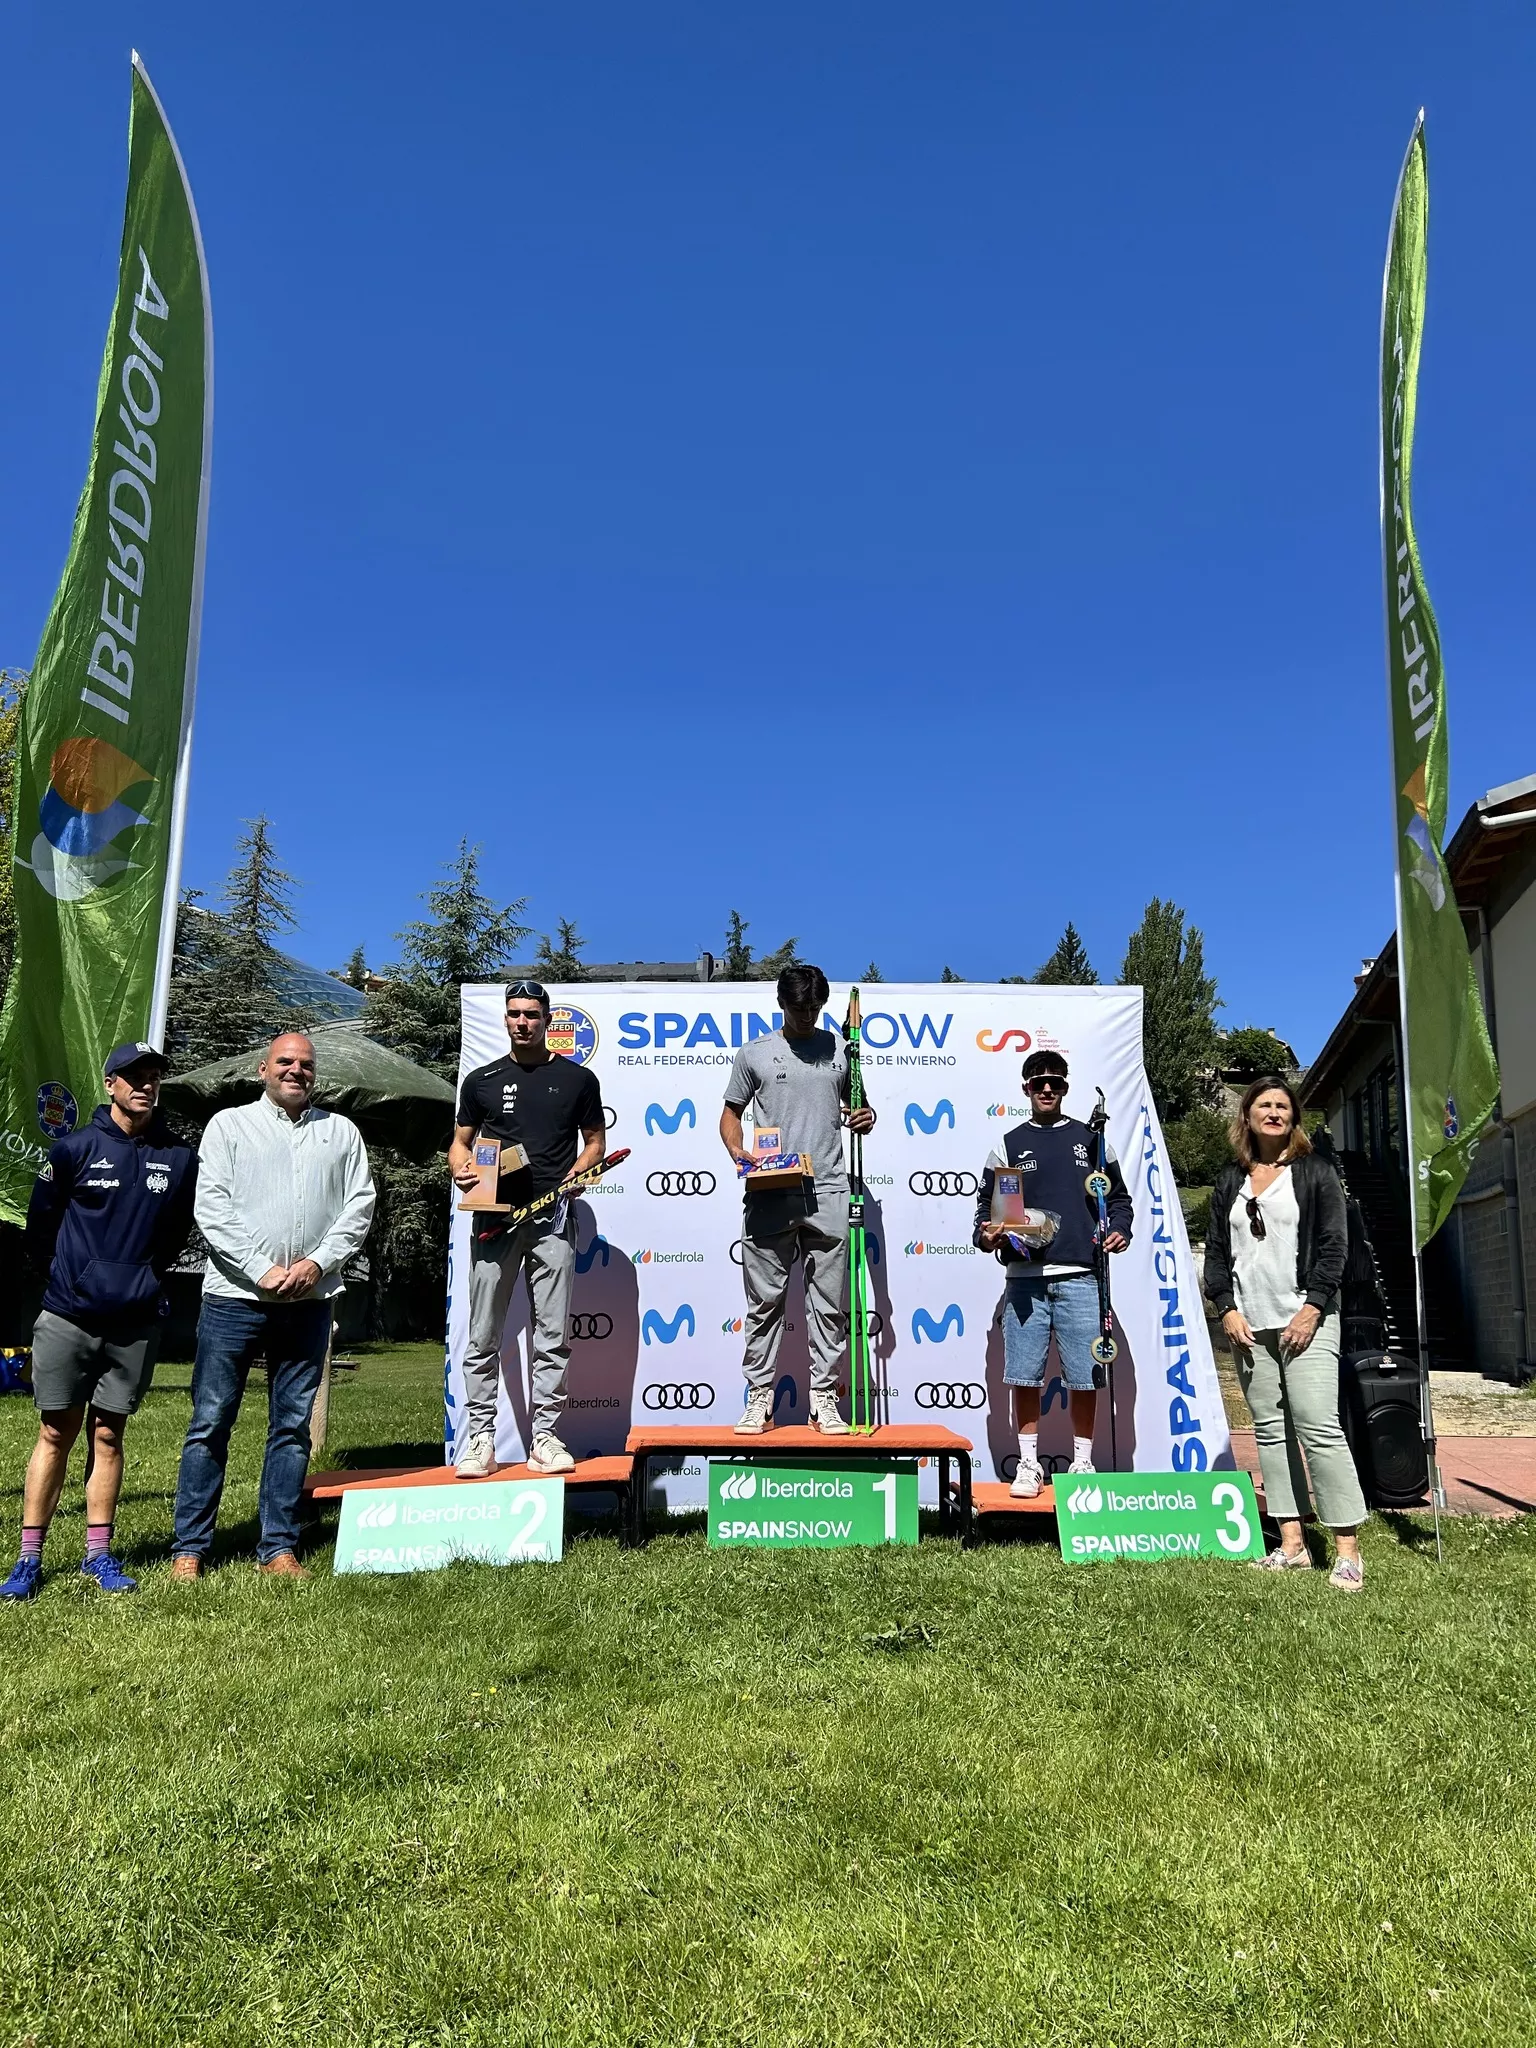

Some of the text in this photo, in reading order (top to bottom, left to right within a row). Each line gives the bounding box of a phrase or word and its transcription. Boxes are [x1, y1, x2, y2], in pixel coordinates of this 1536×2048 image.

[618, 1055, 651, 1066] REAL
[654, 1053, 734, 1066] FEDERACIÓN
[877, 1056, 893, 1066] DE
[897, 1056, 957, 1067] INVIERNO
[531, 1191, 555, 1213] SKI
[653, 1251, 704, 1264] Iberdrola
[925, 1243, 976, 1256] Iberdrola
[568, 1396, 620, 1409] Iberdrola
[650, 1464, 701, 1477] Iberdrola
[761, 1477, 854, 1499] Iberdrola
[872, 1472, 898, 1539] 1
[1107, 1490, 1197, 1512] Iberdrola
[401, 1503, 501, 1525] Iberdrola
[507, 1490, 548, 1555] 2
[1211, 1483, 1251, 1553] 3
[718, 1519, 853, 1540] SPAINSNOW
[1071, 1533, 1201, 1556] SPAINSNOW
